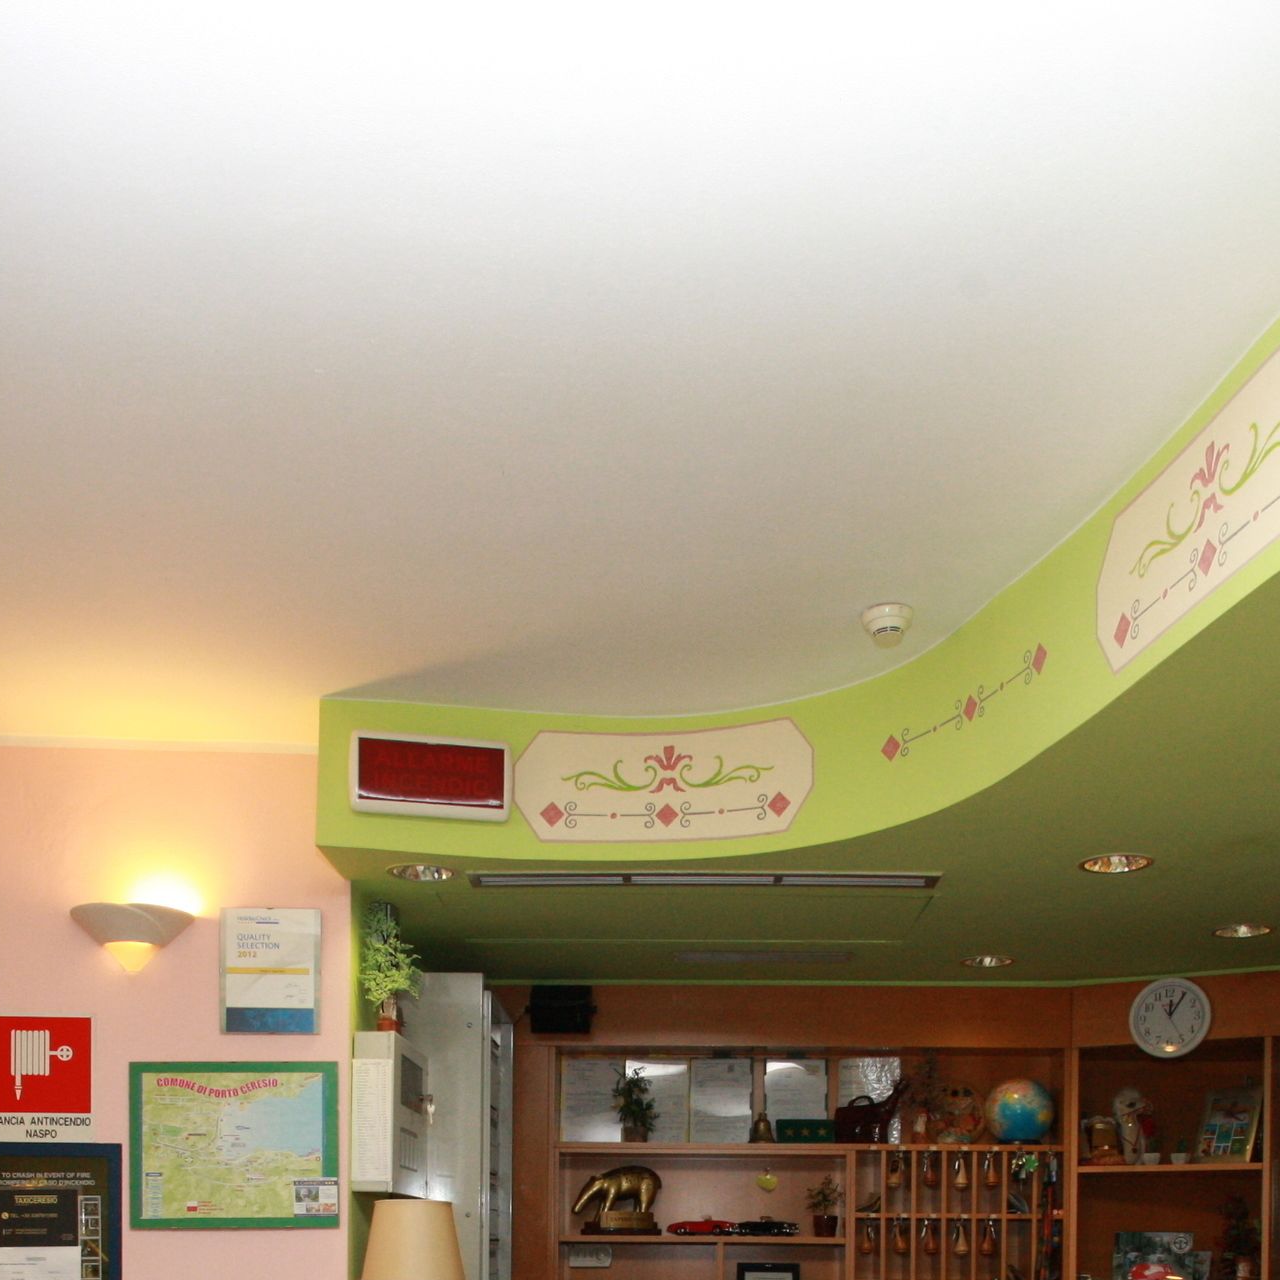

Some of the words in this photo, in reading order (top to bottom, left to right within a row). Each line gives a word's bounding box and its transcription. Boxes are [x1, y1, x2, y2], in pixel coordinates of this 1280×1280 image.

[236, 933, 271, 942] QUALITY
[236, 942, 280, 950] SELECTION
[156, 1077, 197, 1091] COMUNE
[196, 1085, 208, 1095] DI
[208, 1088, 239, 1099] PORTO
[240, 1078, 278, 1095] CERESIO
[30, 1116, 92, 1127] ANTINCENDIO
[25, 1129, 58, 1139] NASPO
